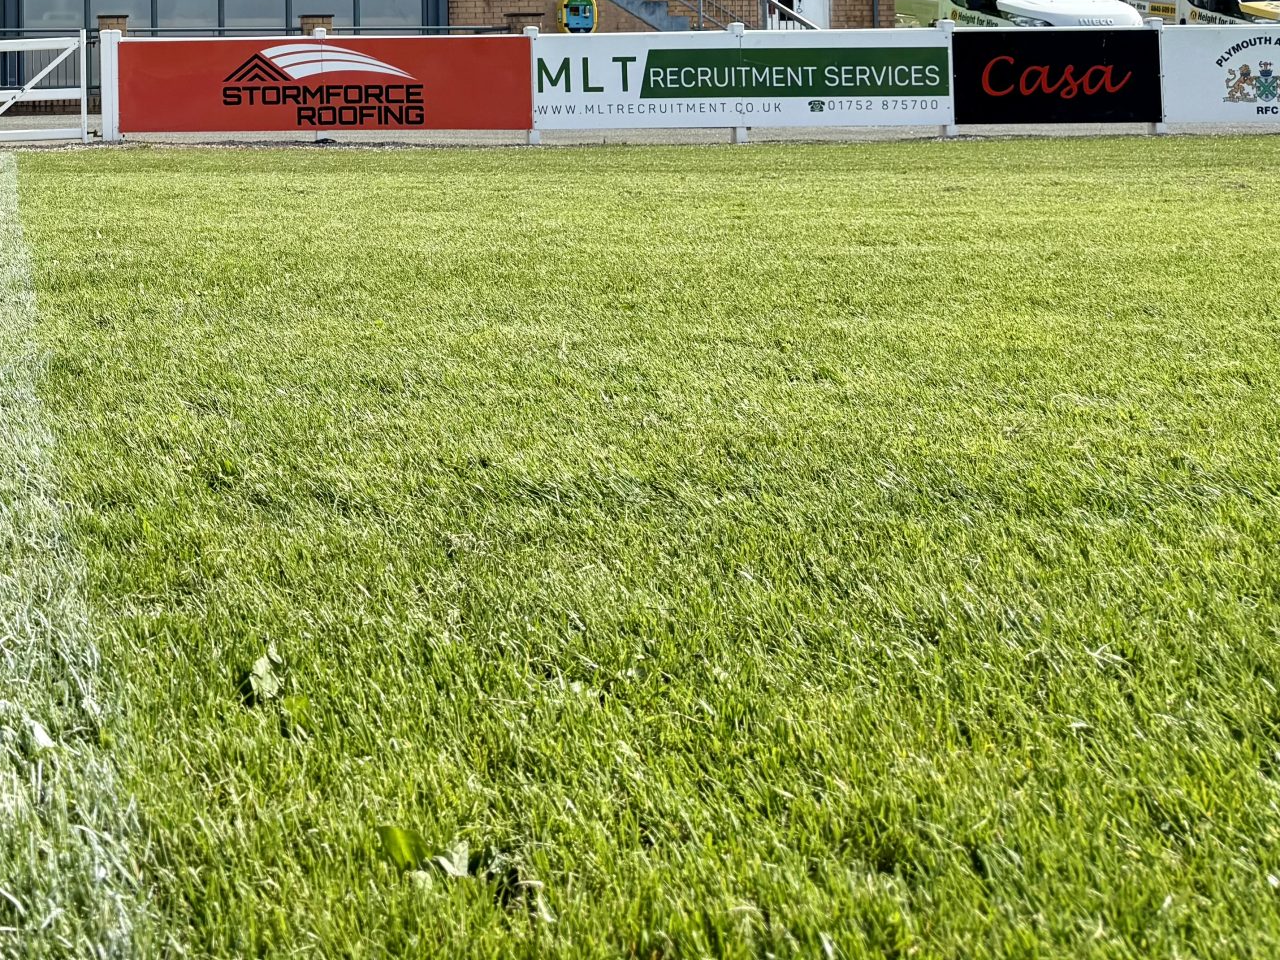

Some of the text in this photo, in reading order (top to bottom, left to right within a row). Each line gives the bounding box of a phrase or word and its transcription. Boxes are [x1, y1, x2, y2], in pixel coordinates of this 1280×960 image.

[958, 11, 976, 25] Height
[977, 17, 985, 26] for
[1197, 11, 1217, 25] Height
[1215, 36, 1272, 68] PLYMOUTH
[537, 56, 940, 94] MLT RECRUITMENT SERVICES
[981, 55, 1132, 99] Casa
[222, 84, 424, 106] STORMFORCE
[297, 105, 425, 126] ROOFING
[537, 99, 939, 115] WWW.MLTRECRUITMENT.CO.UK 01752 875700
[1256, 106, 1279, 115] RFC
